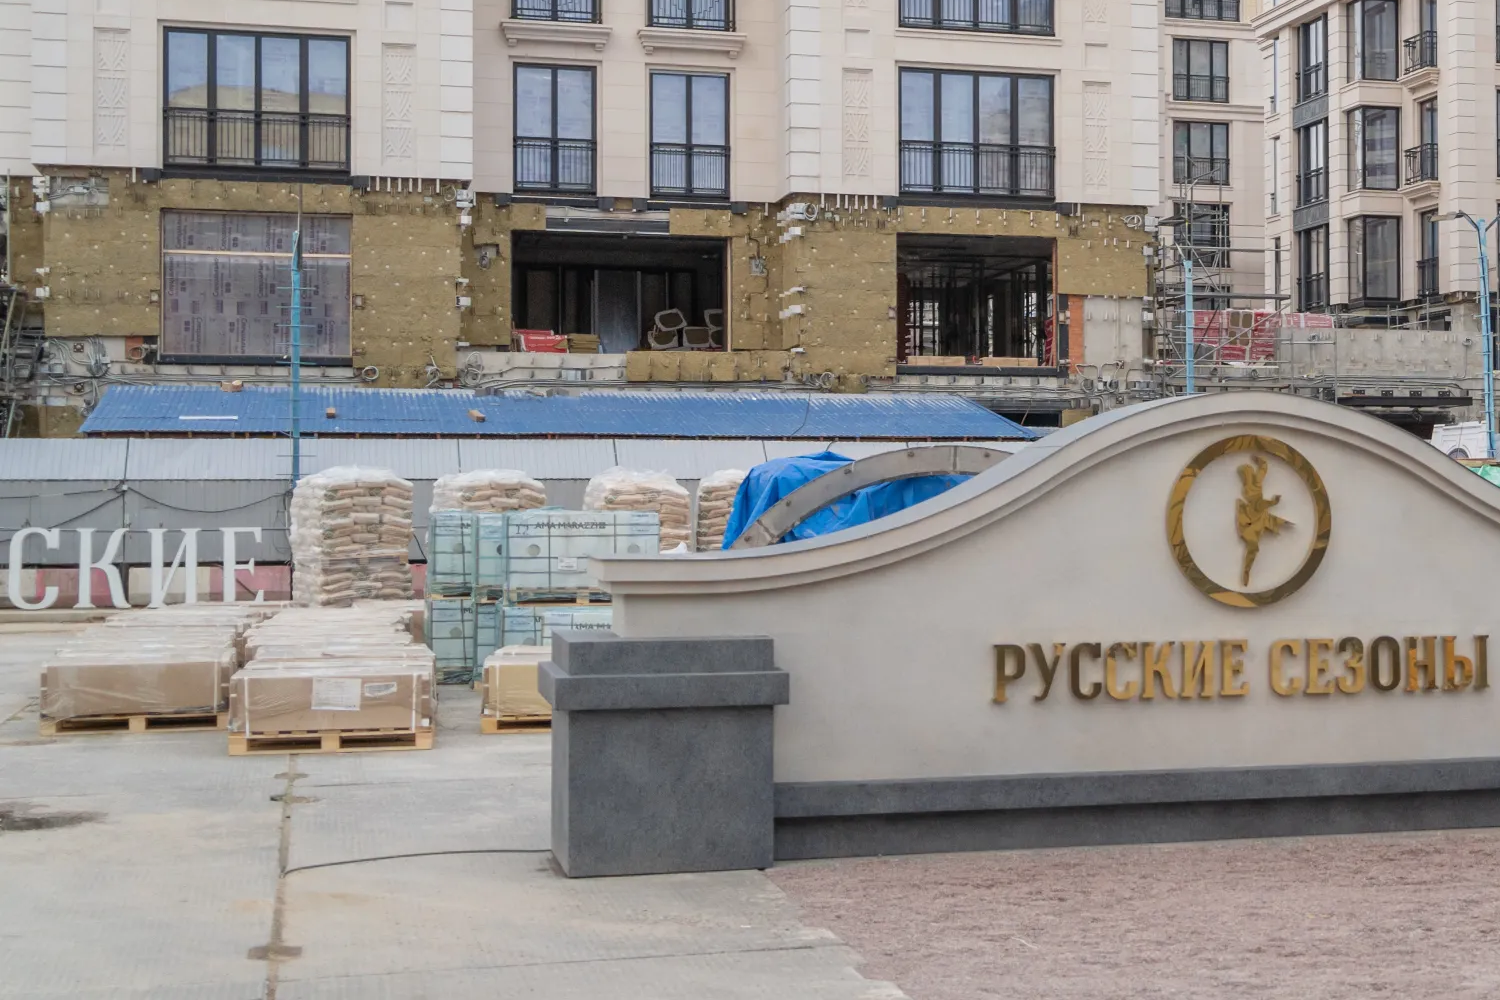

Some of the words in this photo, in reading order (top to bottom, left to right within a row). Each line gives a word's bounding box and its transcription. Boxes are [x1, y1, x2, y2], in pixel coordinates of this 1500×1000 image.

[8, 527, 264, 610] СКИЕ
[991, 638, 1250, 704] РУССКИЕ
[1270, 634, 1490, 697] СЕЗОНЫ
